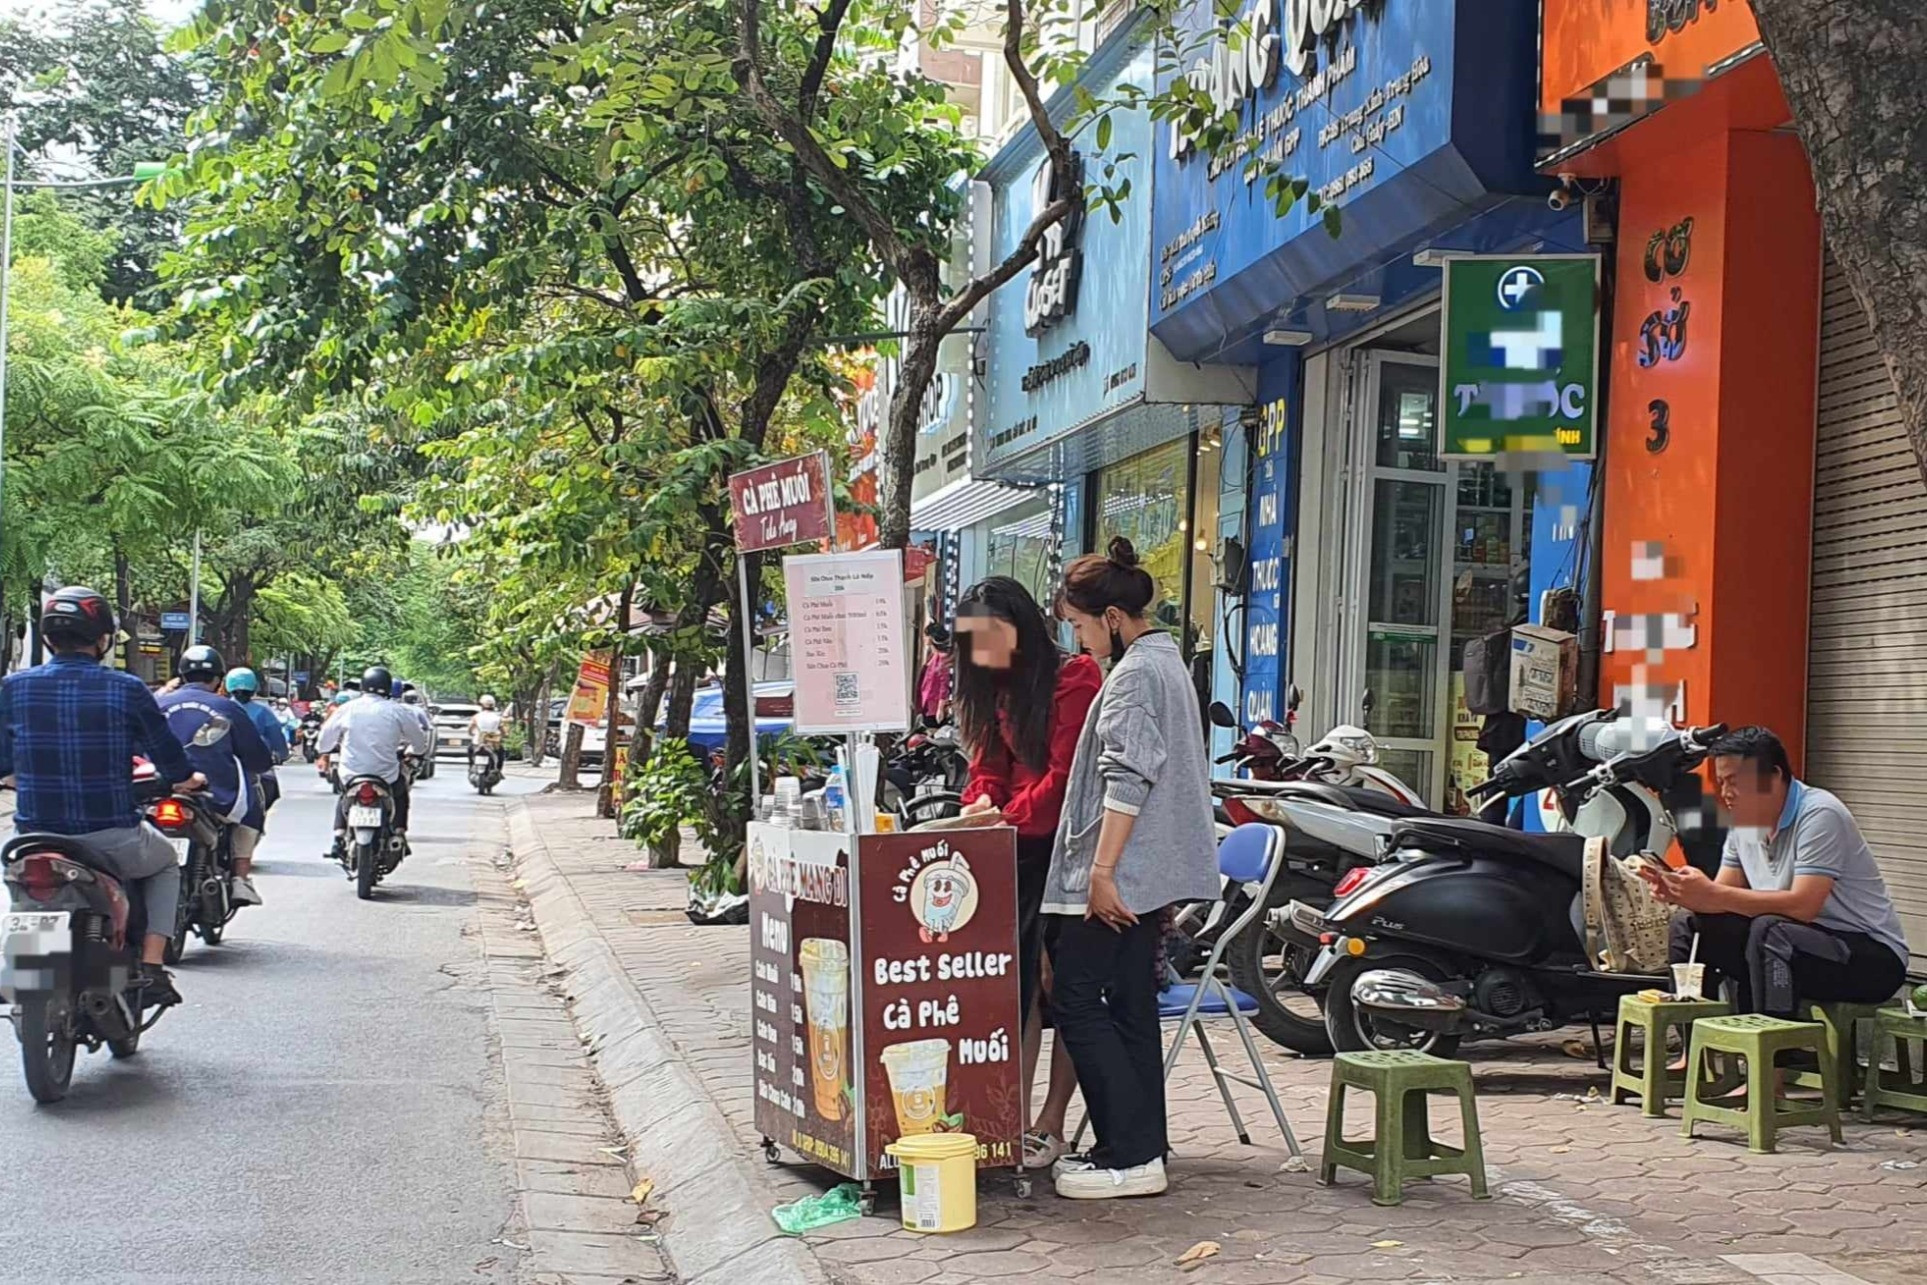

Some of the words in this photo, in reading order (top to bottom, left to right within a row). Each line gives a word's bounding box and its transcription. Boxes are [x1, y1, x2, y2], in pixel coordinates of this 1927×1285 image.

[1256, 397, 1286, 457] GPP
[1645, 398, 1670, 454] 3
[742, 478, 760, 516] CÀ
[757, 471, 781, 512] PHÊ
[779, 459, 812, 508] MUỐI
[1259, 483, 1278, 528] NHÀ
[1252, 541, 1280, 593] THUỐC
[1250, 615, 1278, 656] HOÀNG
[1247, 681, 1273, 722] QUÂN
[799, 861, 833, 904] MANG
[833, 865, 849, 908] ĐI
[898, 855, 921, 884] Phê
[892, 884, 909, 903] Cà
[874, 957, 931, 985] Best
[937, 951, 1013, 980] Seller
[883, 998, 912, 1030] Cà
[919, 994, 960, 1028] Phê
[959, 1027, 1010, 1065] Muối
[990, 1141, 1012, 1159] 141
